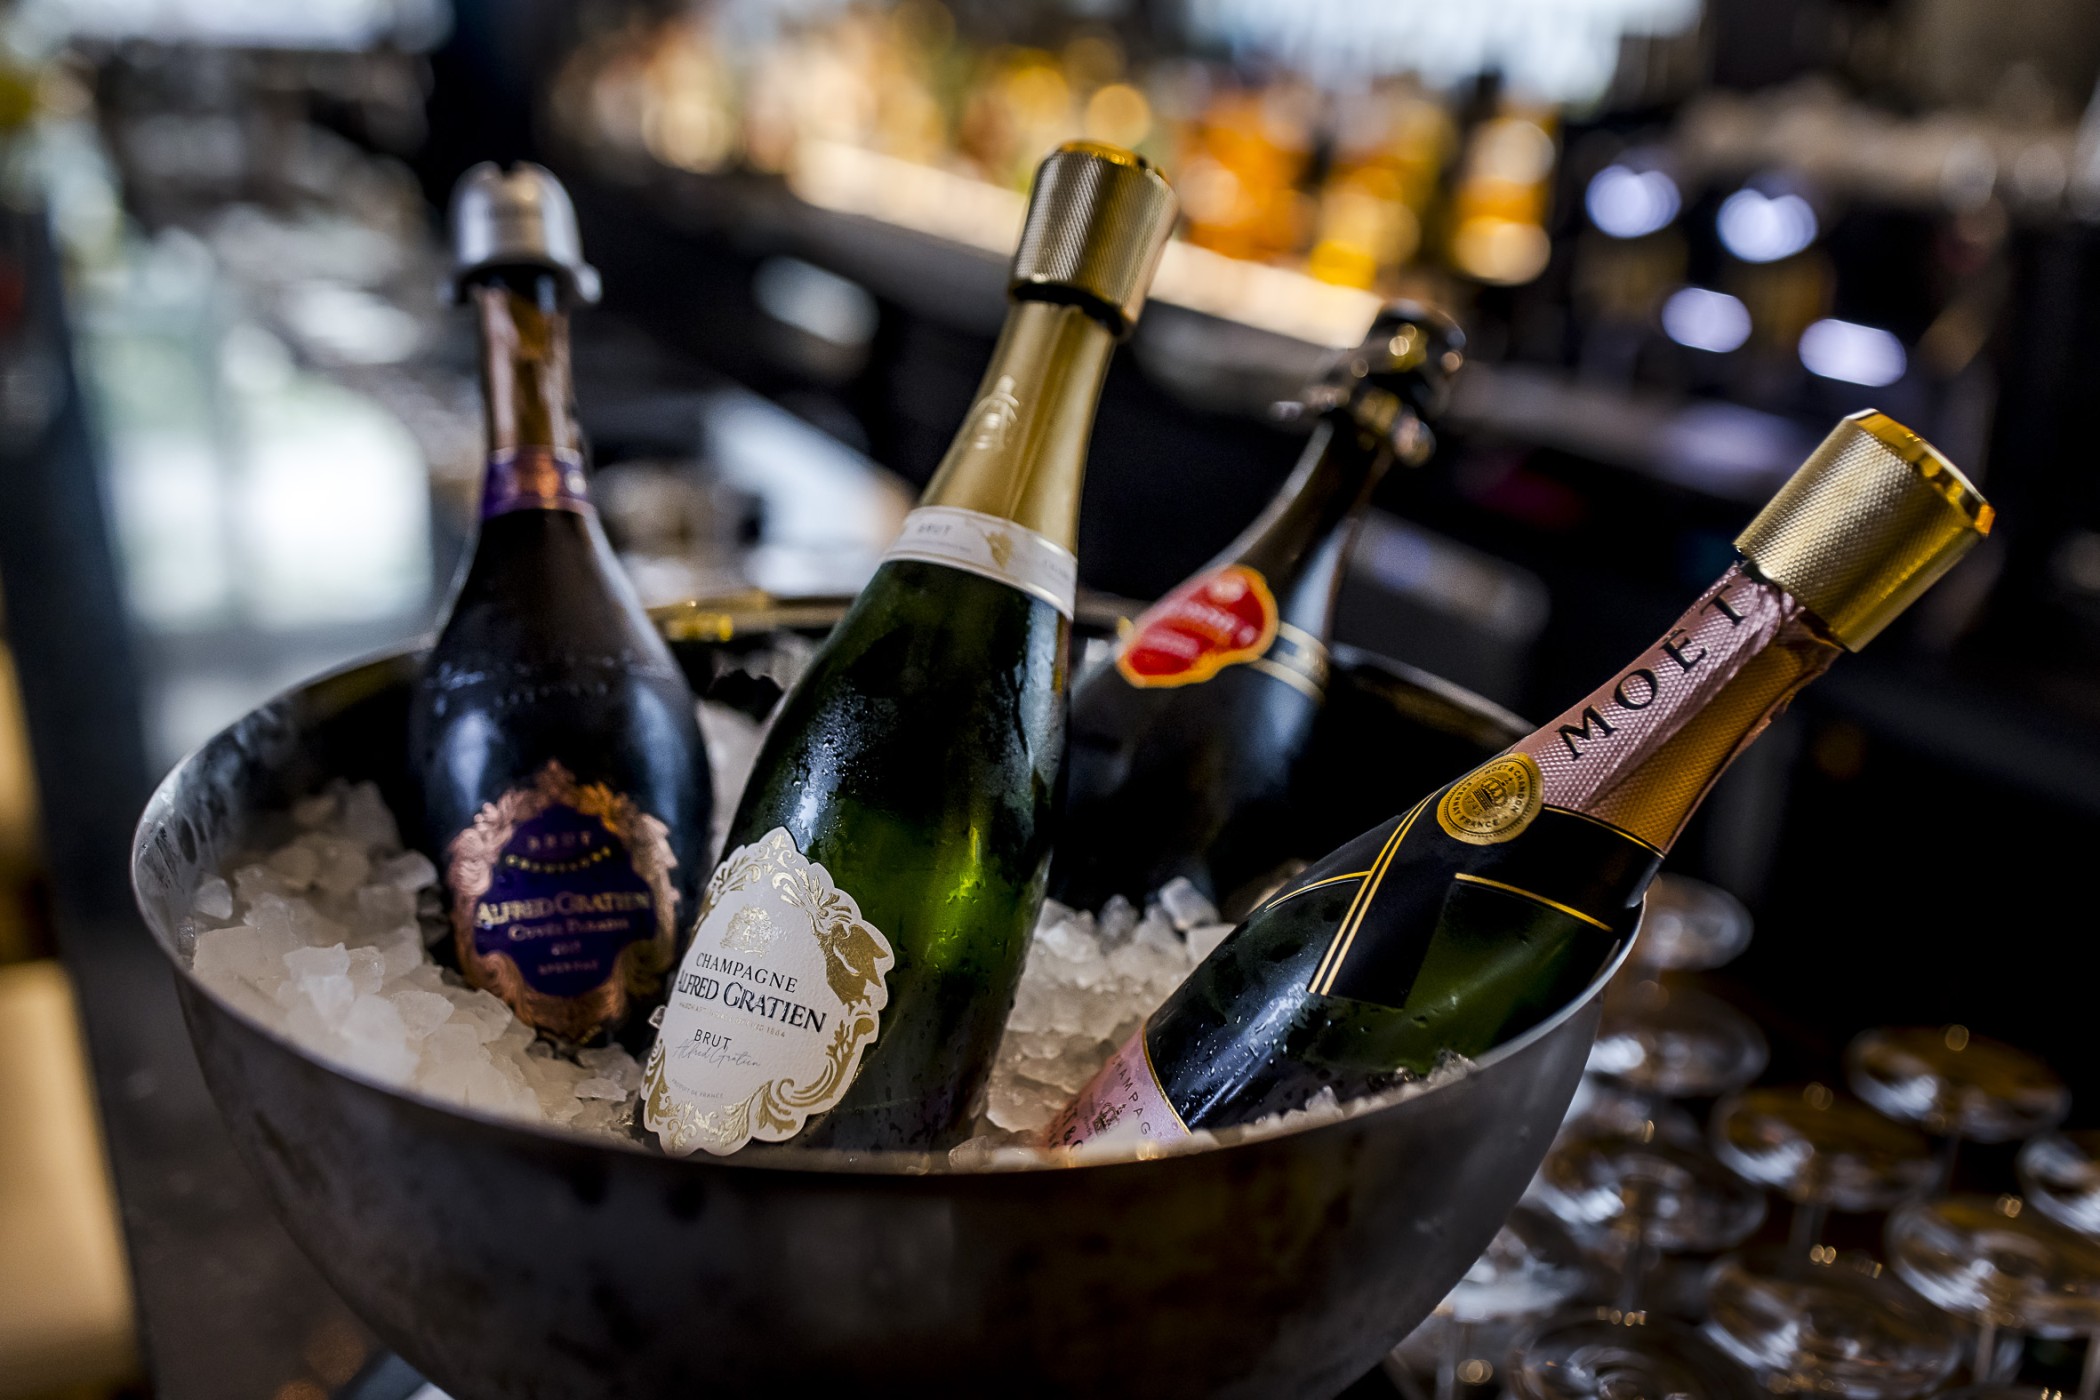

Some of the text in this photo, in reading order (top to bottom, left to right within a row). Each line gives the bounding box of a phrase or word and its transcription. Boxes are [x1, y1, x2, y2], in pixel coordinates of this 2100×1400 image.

[1459, 815, 1500, 828] FRANCE
[696, 952, 798, 993] CHAMPAGNE
[723, 982, 827, 1033] GRATIEN
[694, 1029, 732, 1050] BRUT
